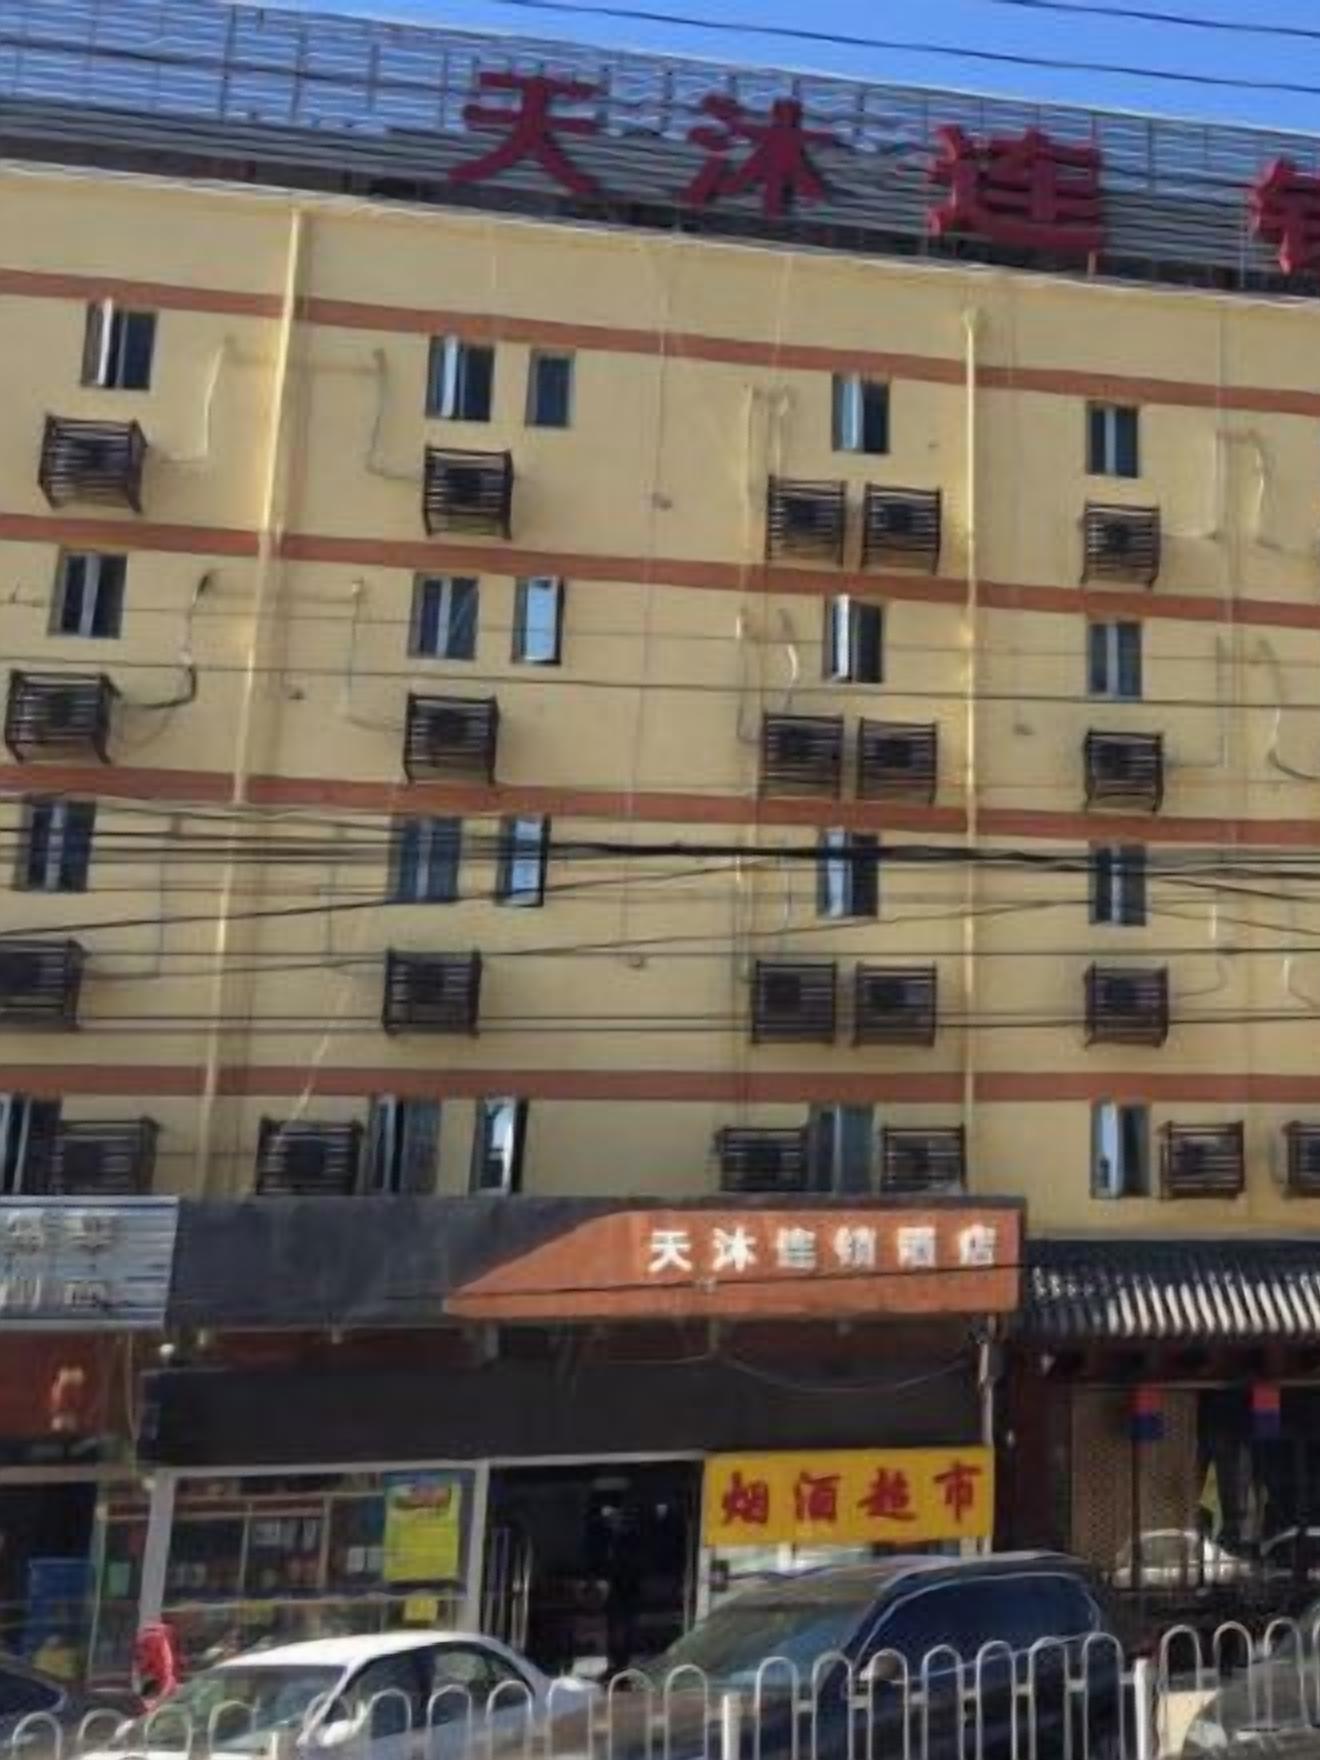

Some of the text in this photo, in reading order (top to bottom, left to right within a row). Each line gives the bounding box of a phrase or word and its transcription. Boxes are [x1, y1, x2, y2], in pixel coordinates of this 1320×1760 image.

[648, 1224, 998, 1272] 天沐连锁酒店
[720, 1458, 984, 1527] 烟酒超市
